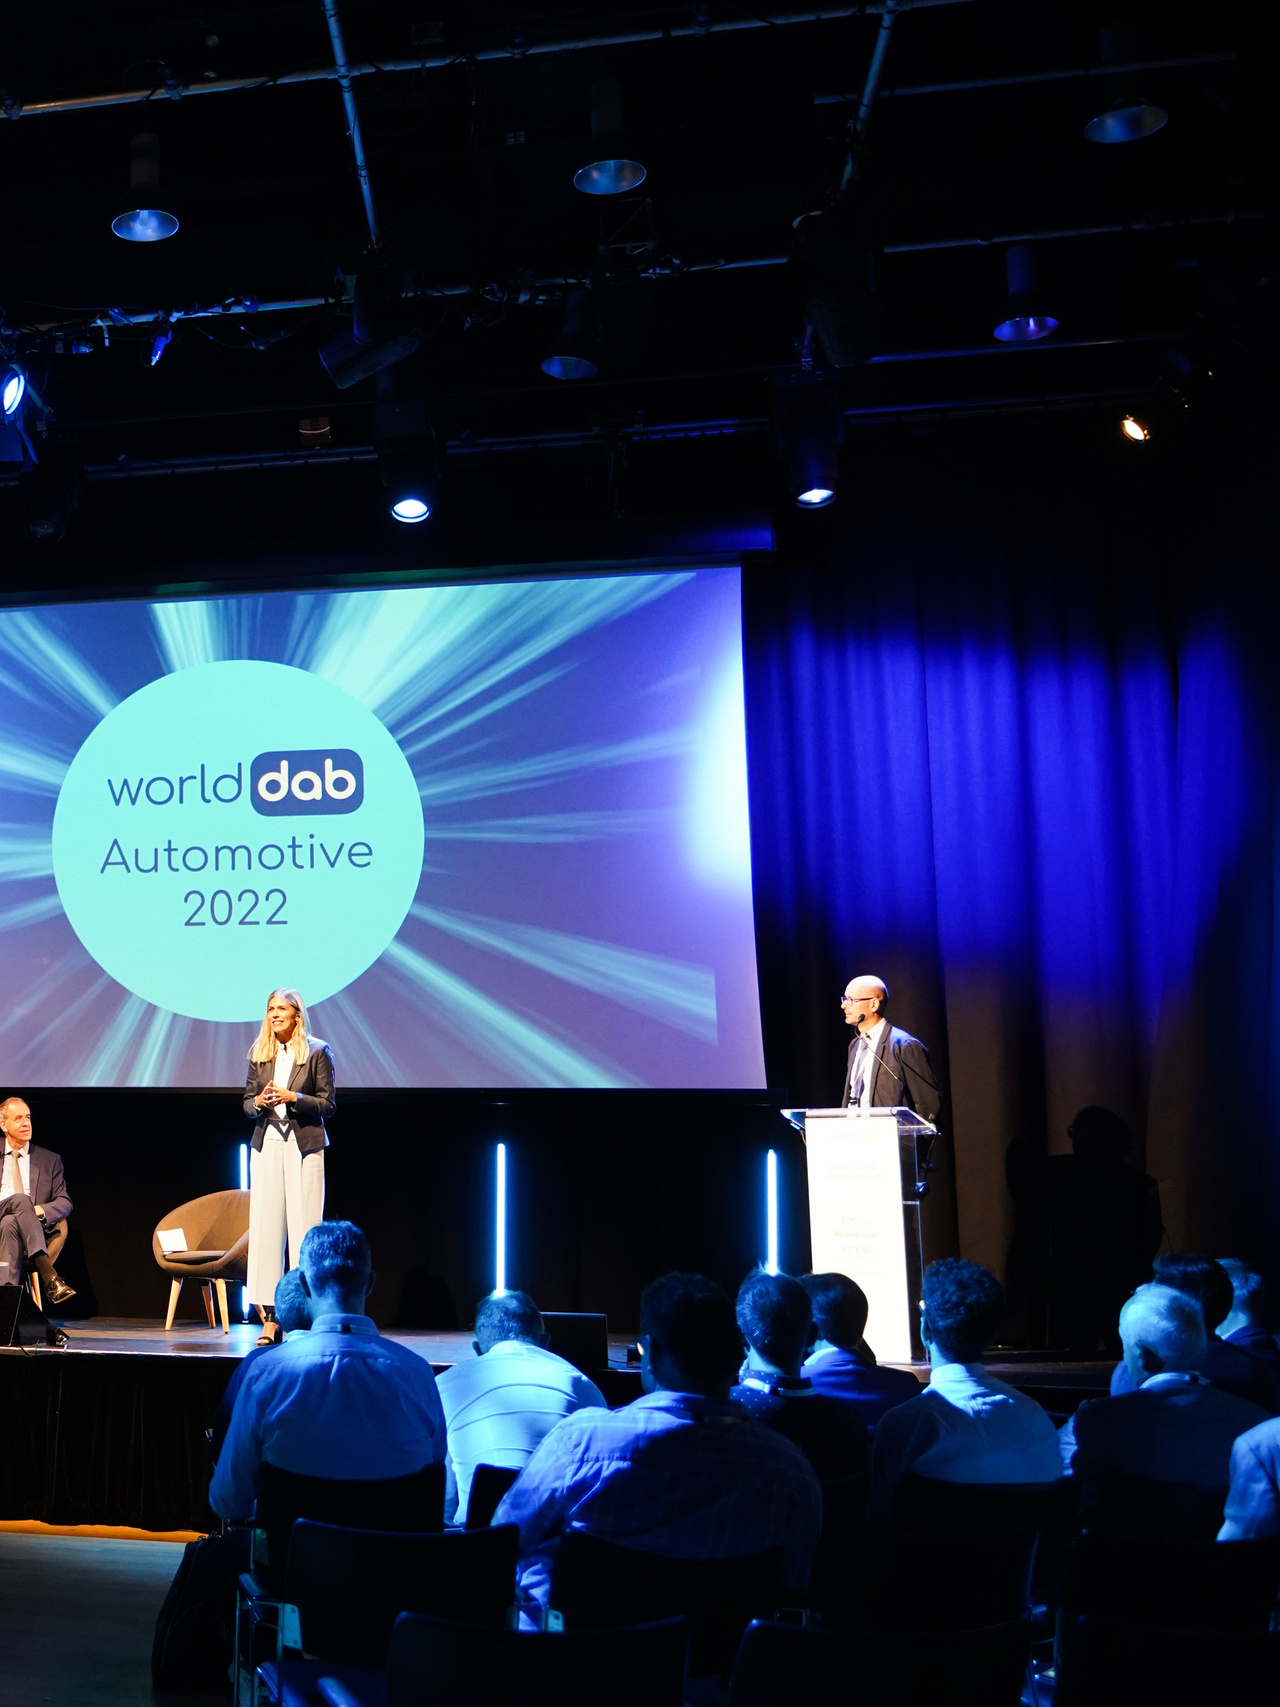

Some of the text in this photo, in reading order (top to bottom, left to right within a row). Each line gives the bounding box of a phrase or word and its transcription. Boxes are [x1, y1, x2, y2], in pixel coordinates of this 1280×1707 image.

[107, 758, 356, 806] world dab
[100, 834, 373, 874] Automotive
[183, 888, 288, 926] 2022
